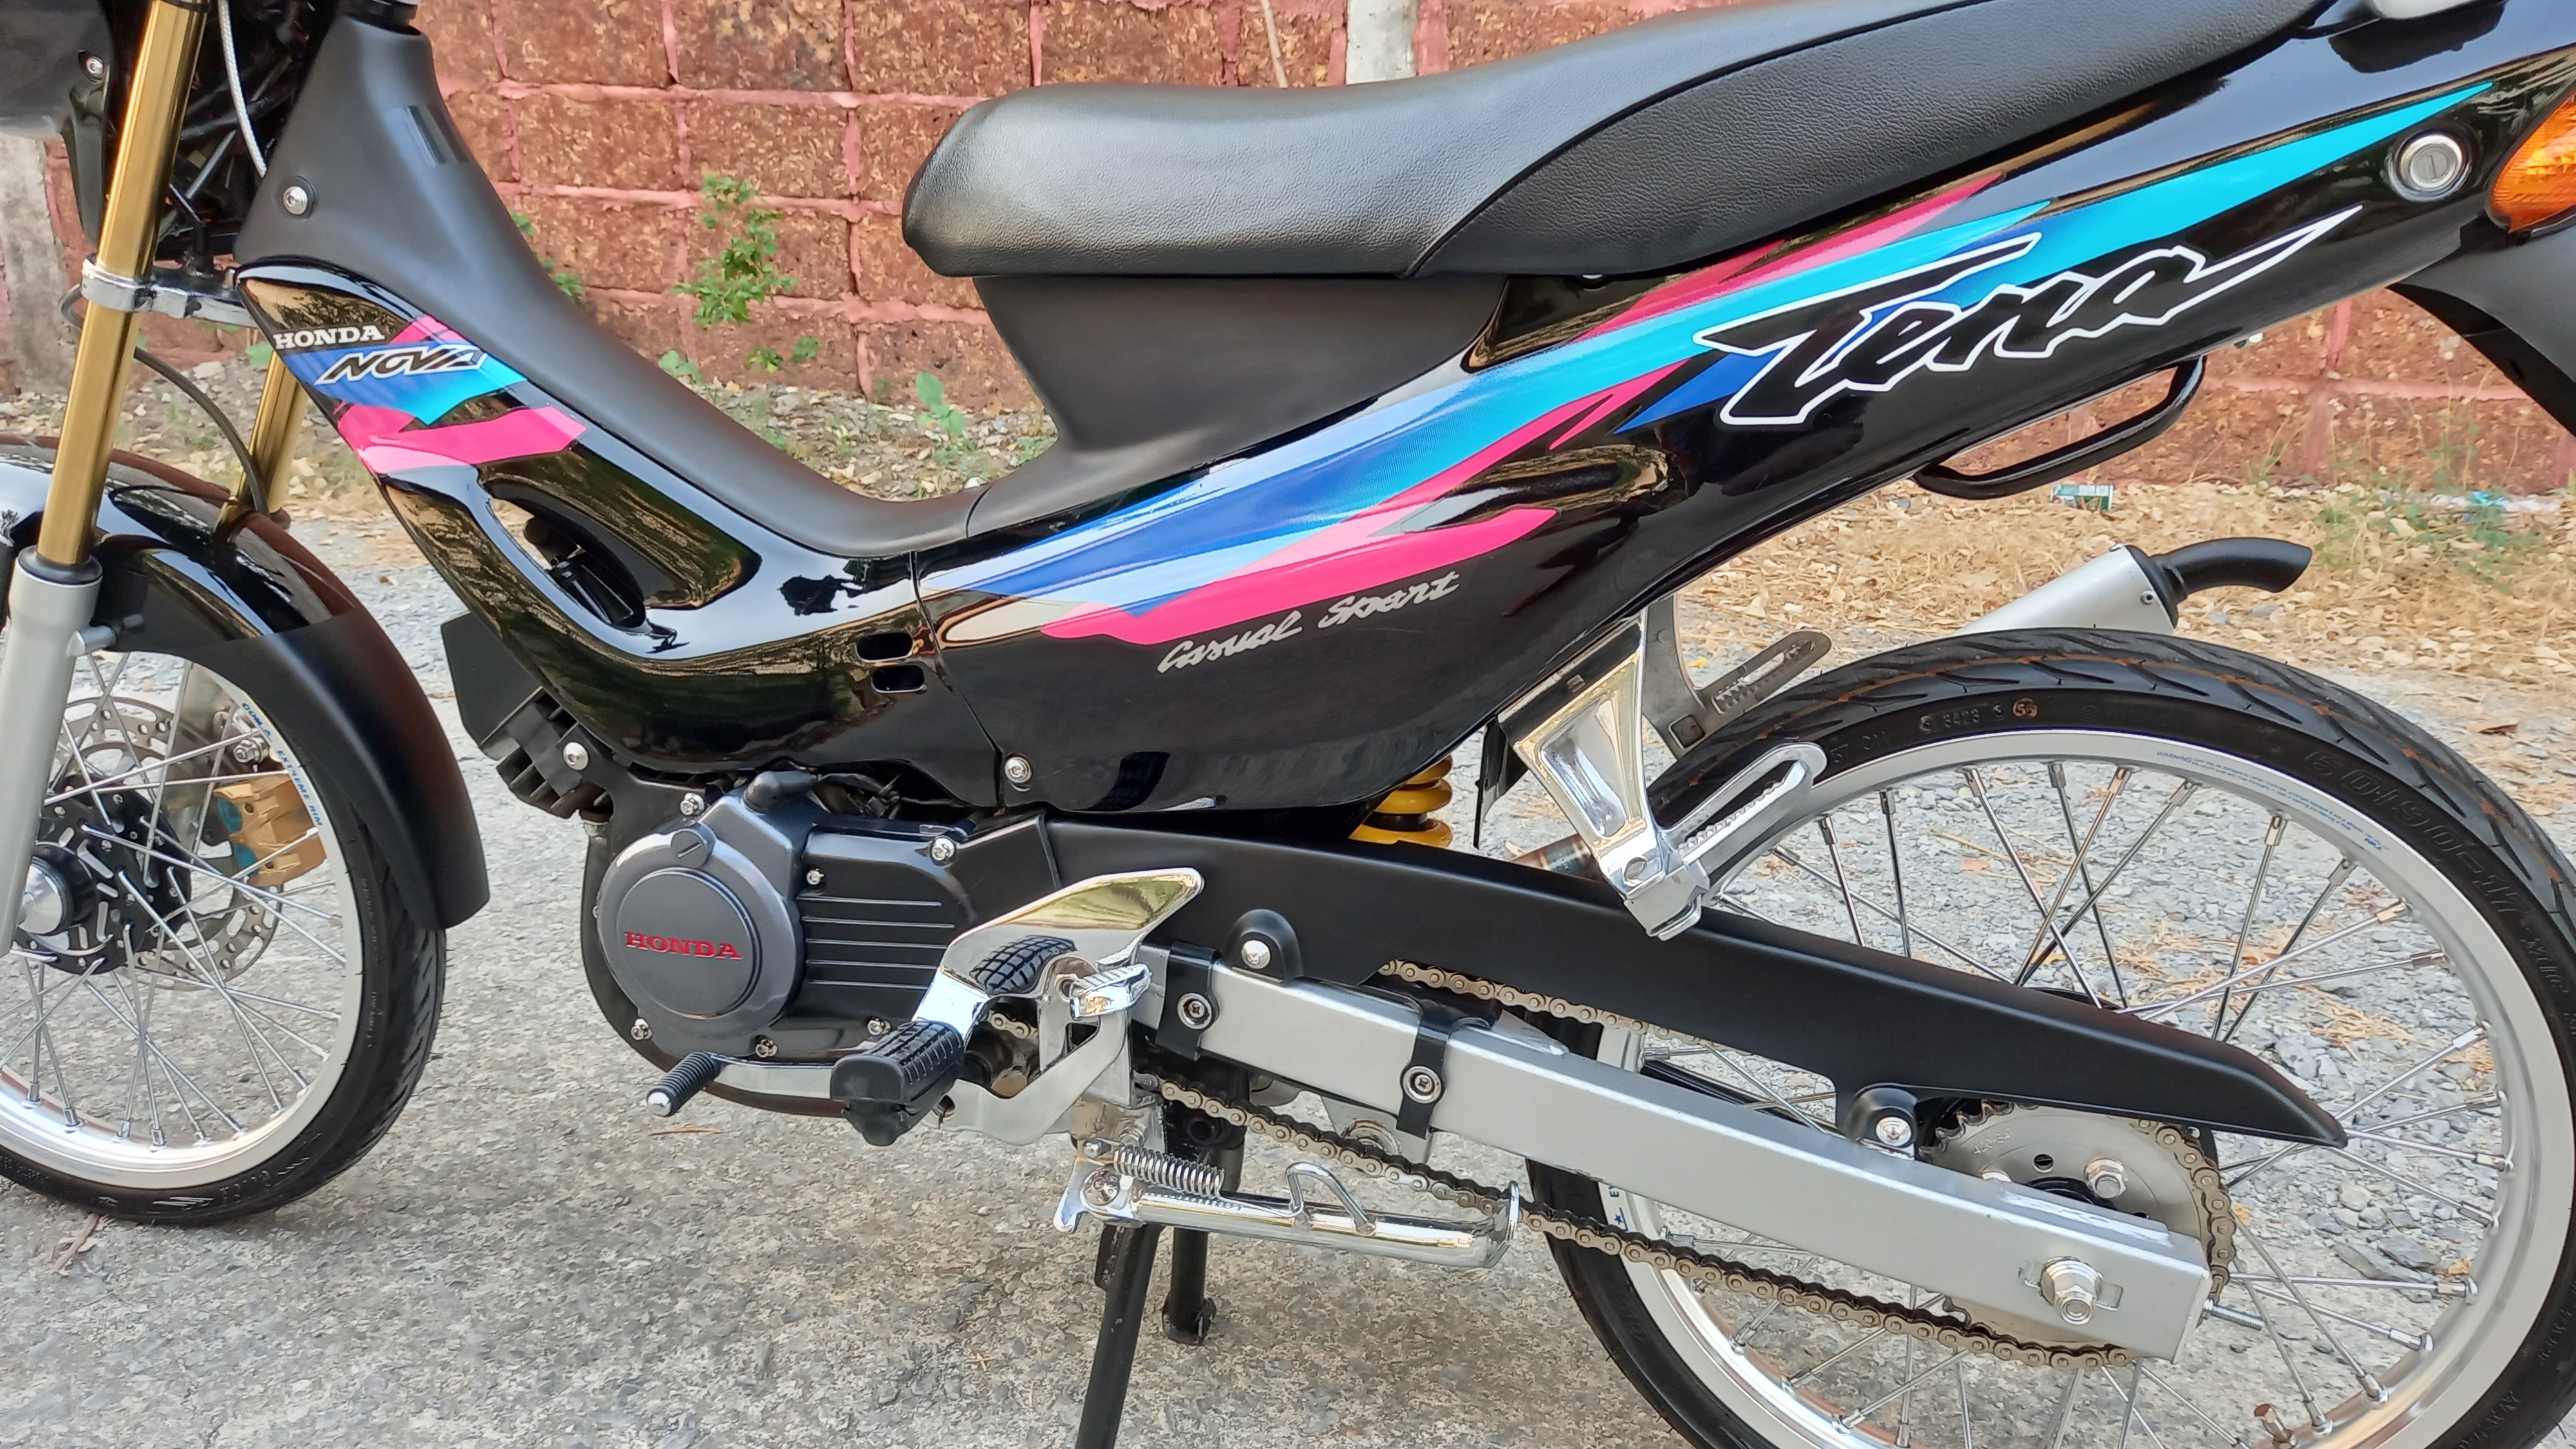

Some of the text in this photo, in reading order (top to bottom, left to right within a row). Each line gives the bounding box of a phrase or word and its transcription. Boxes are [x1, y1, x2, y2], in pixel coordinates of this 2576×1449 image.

[272, 325, 385, 350] HONDA
[314, 345, 488, 386] NOVA
[1157, 610, 1303, 674] Casual
[1942, 709, 1980, 728] 3423
[624, 931, 743, 960] HONDA
